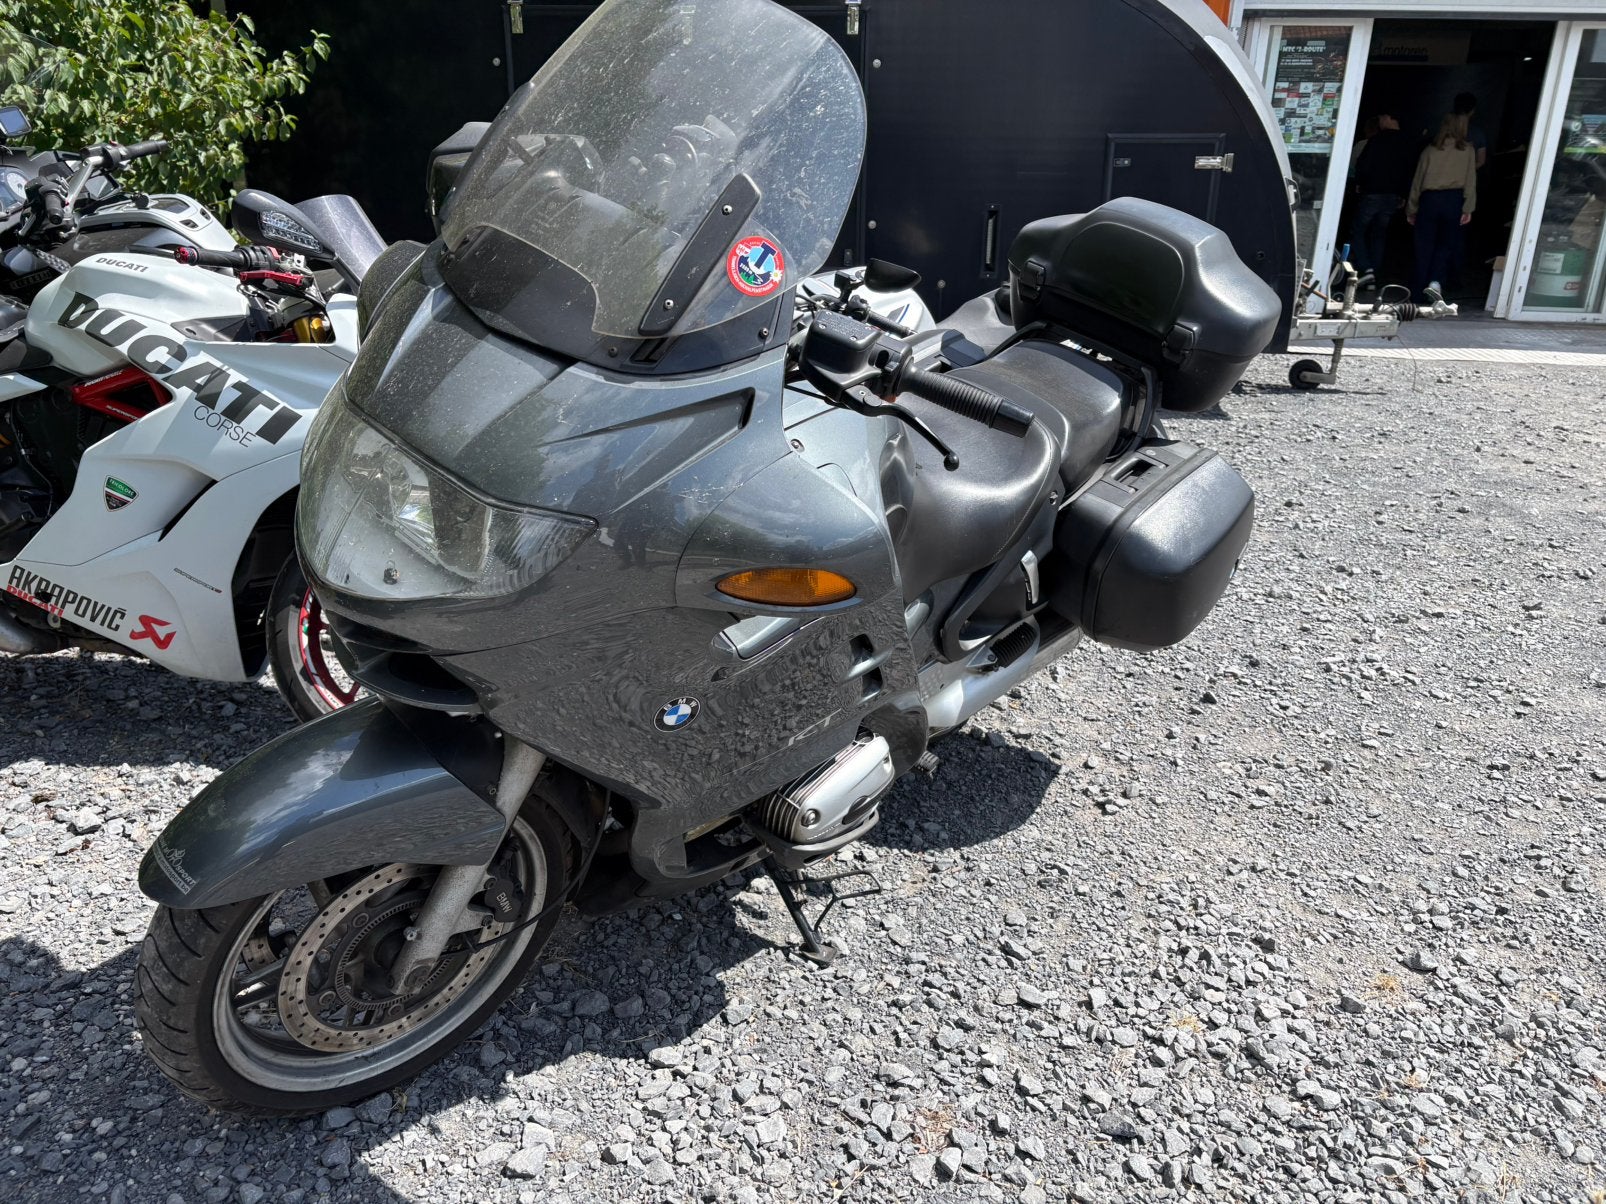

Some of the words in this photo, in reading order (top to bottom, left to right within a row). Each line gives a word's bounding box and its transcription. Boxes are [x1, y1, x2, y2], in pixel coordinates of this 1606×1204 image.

[96, 257, 149, 273] DUCATI
[57, 291, 303, 446] DUCATI
[193, 405, 257, 448] CORSE
[496, 891, 513, 913] BMW
